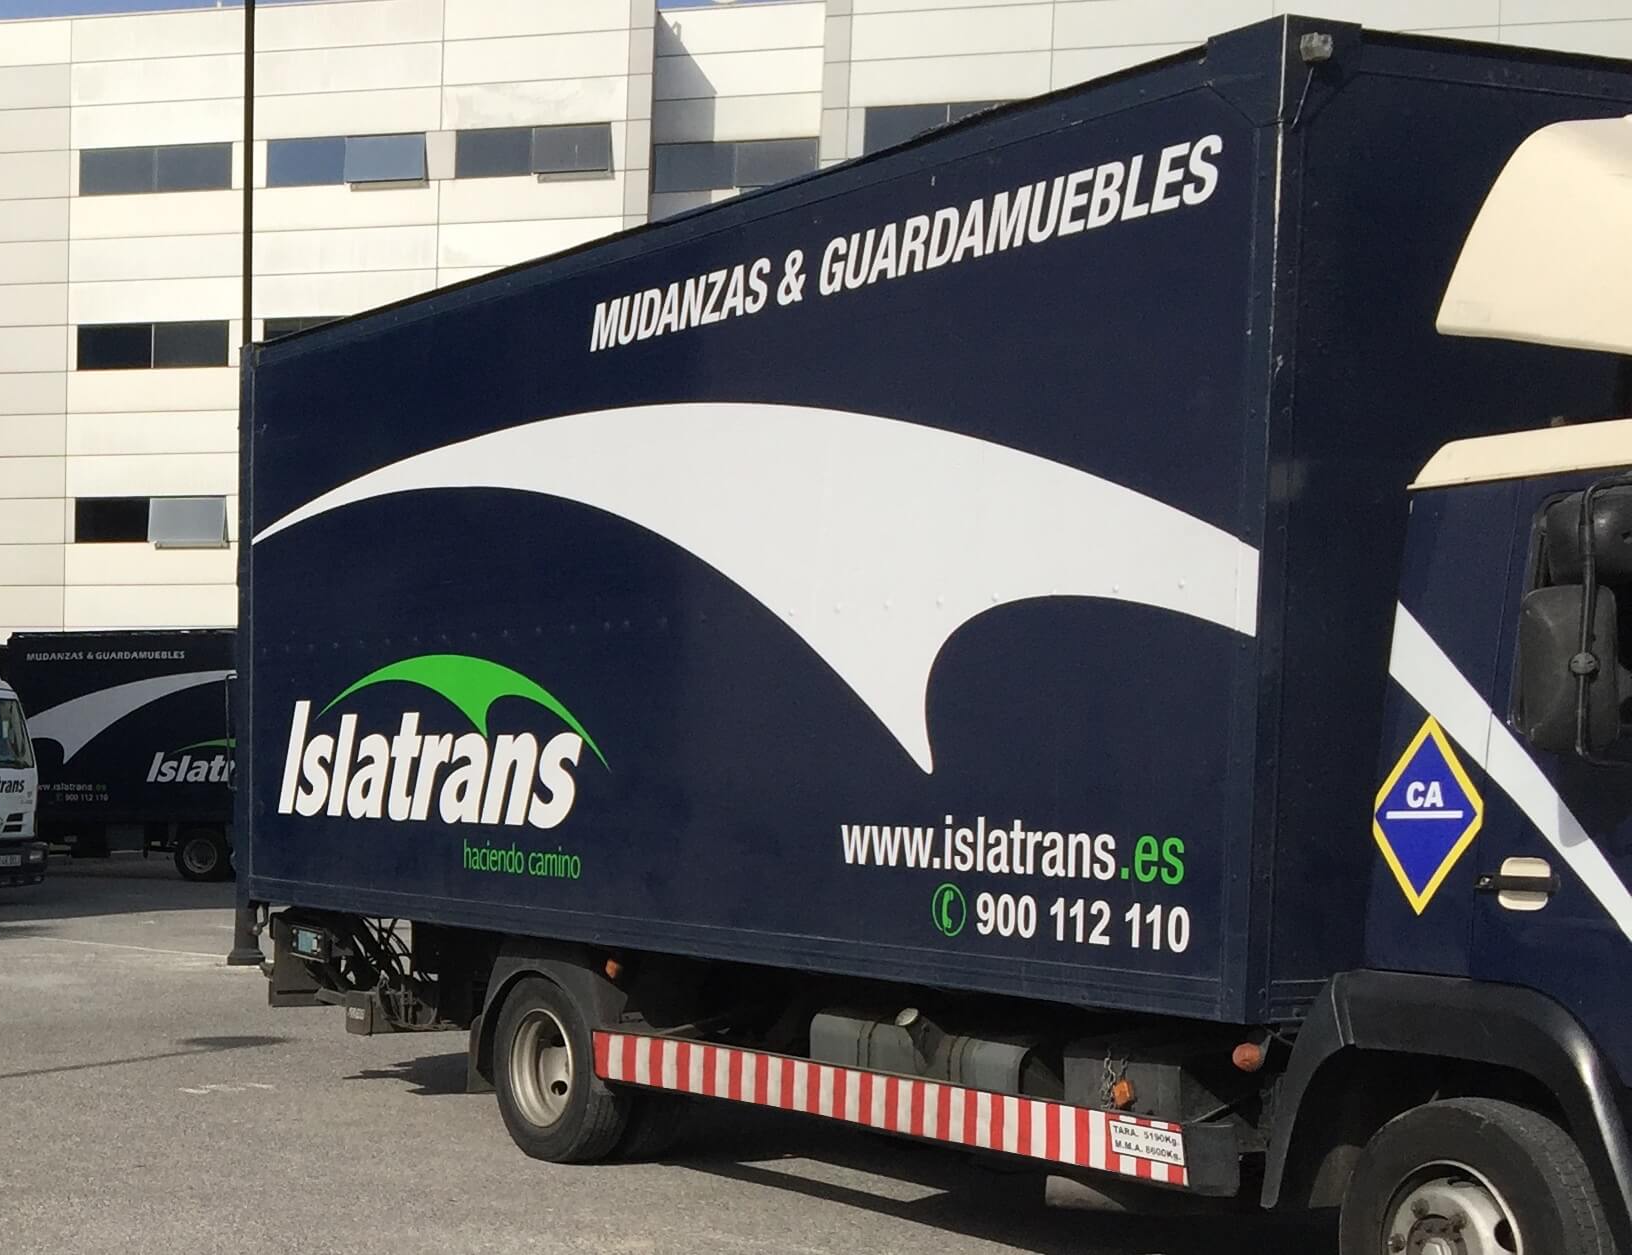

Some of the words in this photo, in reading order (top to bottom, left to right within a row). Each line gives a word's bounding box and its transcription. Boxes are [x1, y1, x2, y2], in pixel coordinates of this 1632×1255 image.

[589, 258, 771, 353] MUDANZAS
[776, 249, 806, 306] &
[819, 134, 1224, 296] GUARDAMUEBLES
[26, 651, 84, 661] MUDANZAS
[86, 651, 94, 660] &
[95, 650, 185, 661] GUARDAMUEBLES
[277, 700, 584, 830] Islatrans
[1405, 781, 1444, 808] CA
[463, 839, 524, 874] haciendo
[528, 846, 581, 880] camino
[840, 814, 1186, 886] www.islatrans.es
[975, 891, 1037, 939] 900
[1049, 897, 1111, 946] 112
[1124, 902, 1190, 953] 110
[1114, 1139, 1143, 1153] M.M.A.
